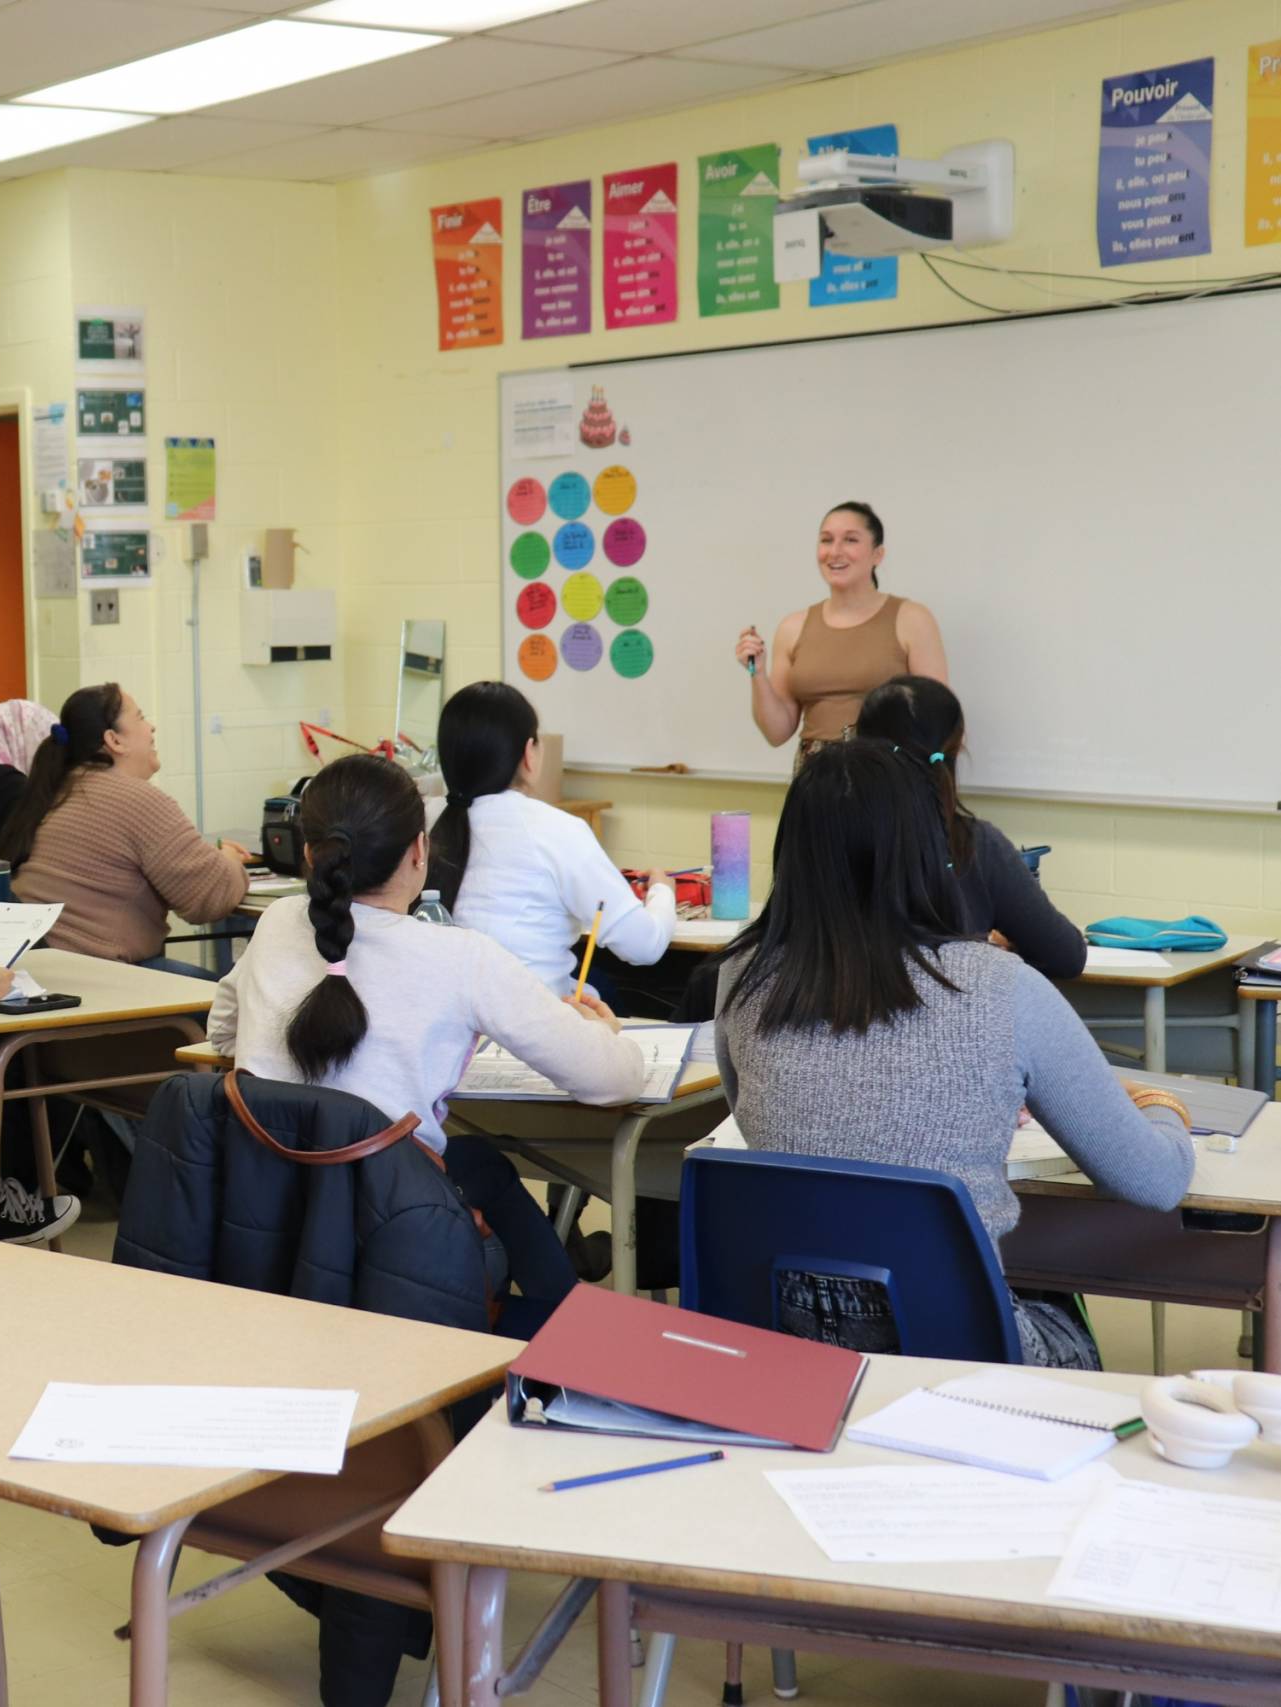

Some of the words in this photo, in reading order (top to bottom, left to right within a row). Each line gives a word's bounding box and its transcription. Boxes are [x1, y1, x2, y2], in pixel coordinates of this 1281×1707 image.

[1112, 79, 1178, 107] Pouvoir
[705, 160, 739, 181] Avoir
[609, 181, 645, 200] Aimer
[527, 194, 552, 215] Être
[437, 213, 463, 231] Finir
